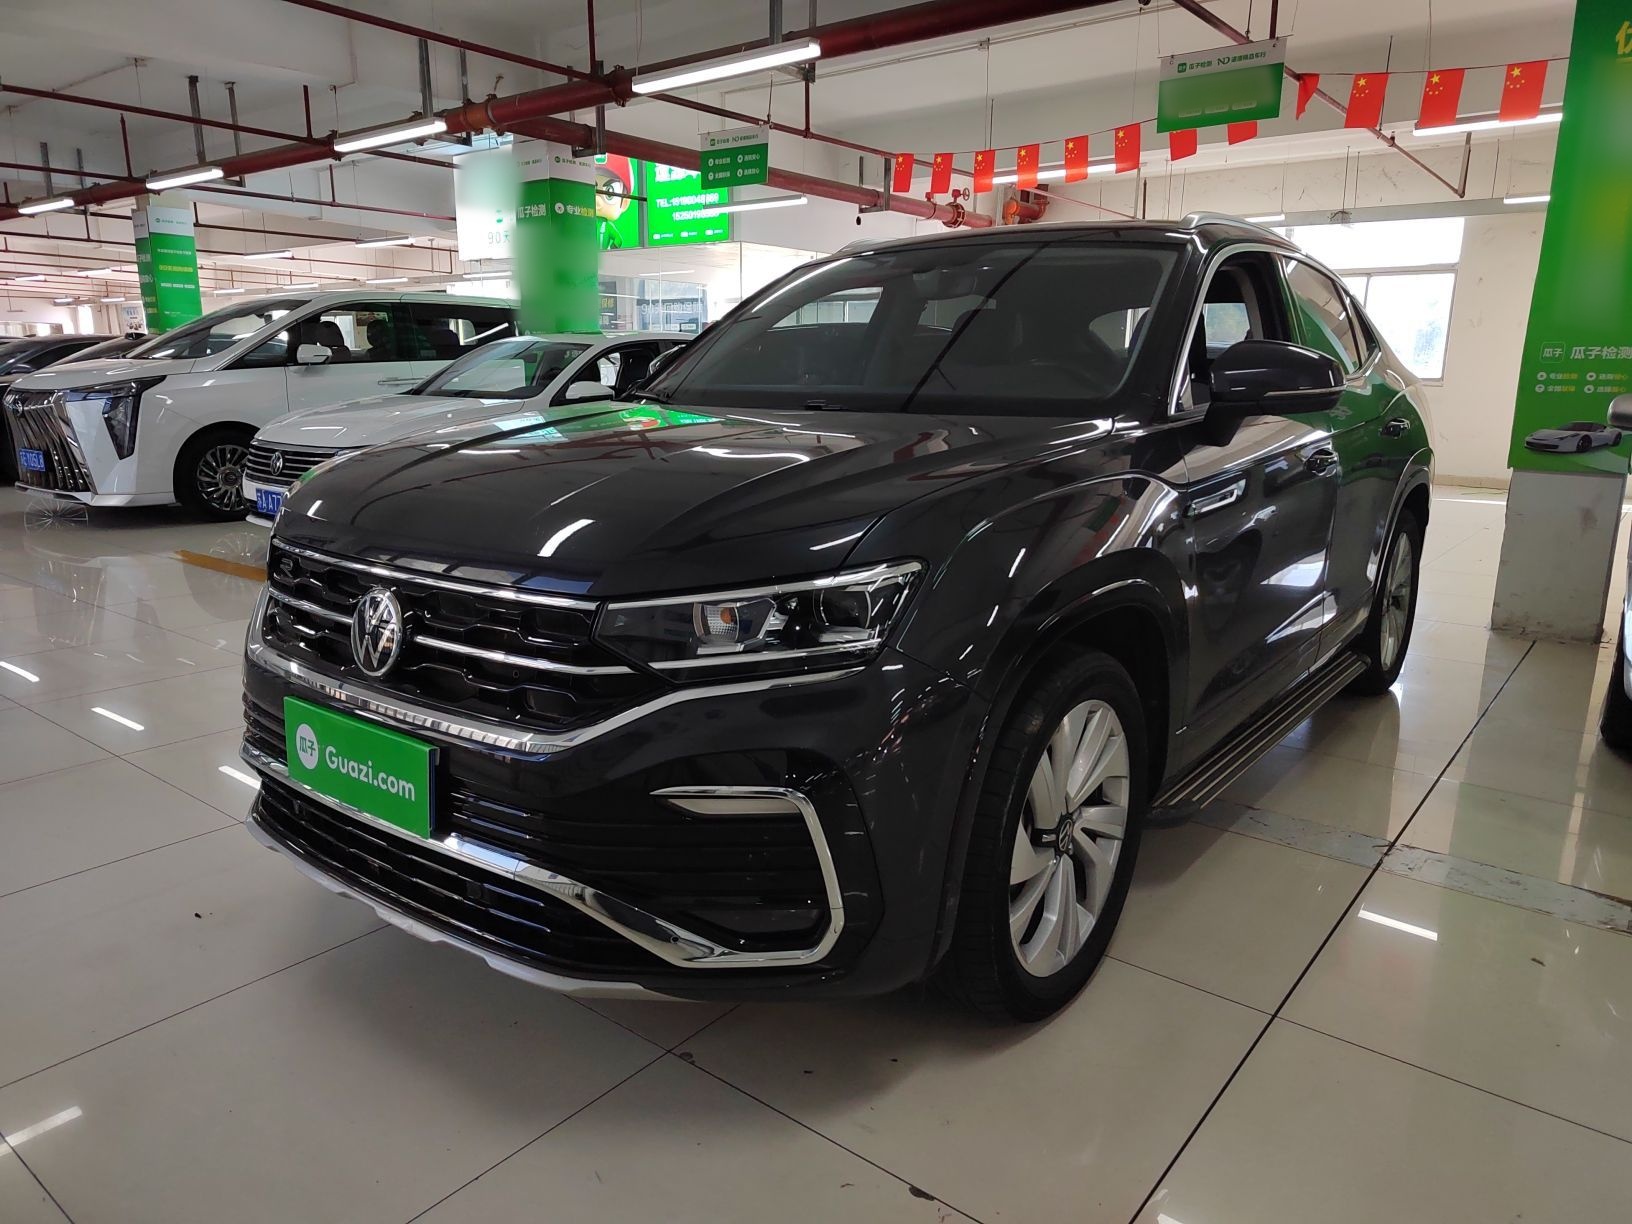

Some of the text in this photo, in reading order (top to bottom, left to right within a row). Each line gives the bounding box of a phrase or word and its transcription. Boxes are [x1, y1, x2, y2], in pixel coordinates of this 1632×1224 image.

[1542, 348, 1563, 358] 瓜子
[299, 735, 416, 802] 瓜子 Guazi.com
